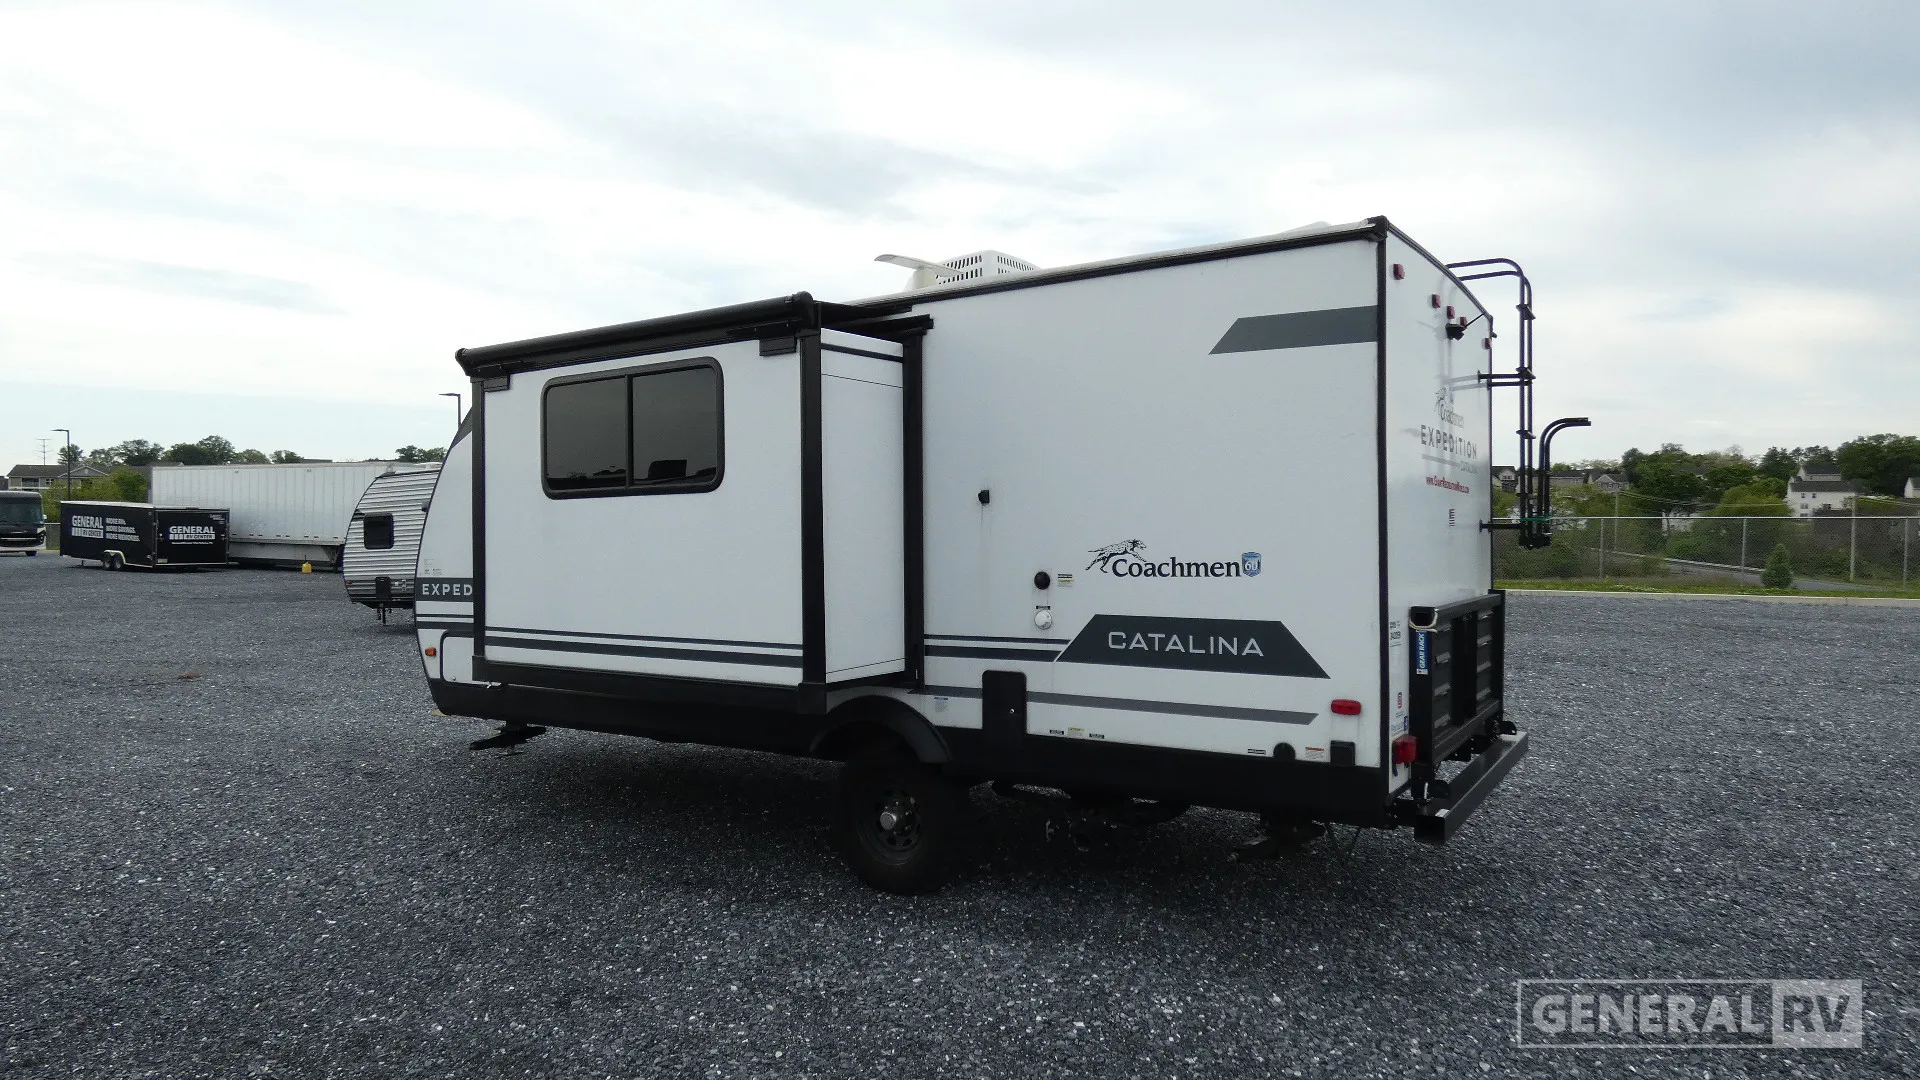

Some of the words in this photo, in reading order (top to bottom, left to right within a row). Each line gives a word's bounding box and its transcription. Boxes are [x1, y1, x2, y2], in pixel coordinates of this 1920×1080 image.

[1420, 424, 1478, 460] EXPEDITION
[72, 515, 103, 529] GENERAL
[169, 526, 215, 534] GENERAL
[1111, 556, 1242, 578] Coachmen
[1244, 561, 1258, 571] 60
[422, 583, 473, 596] EXPED
[1108, 631, 1264, 657] CATALINA
[1418, 633, 1426, 651] RACK
[1418, 651, 1426, 669] GEAR
